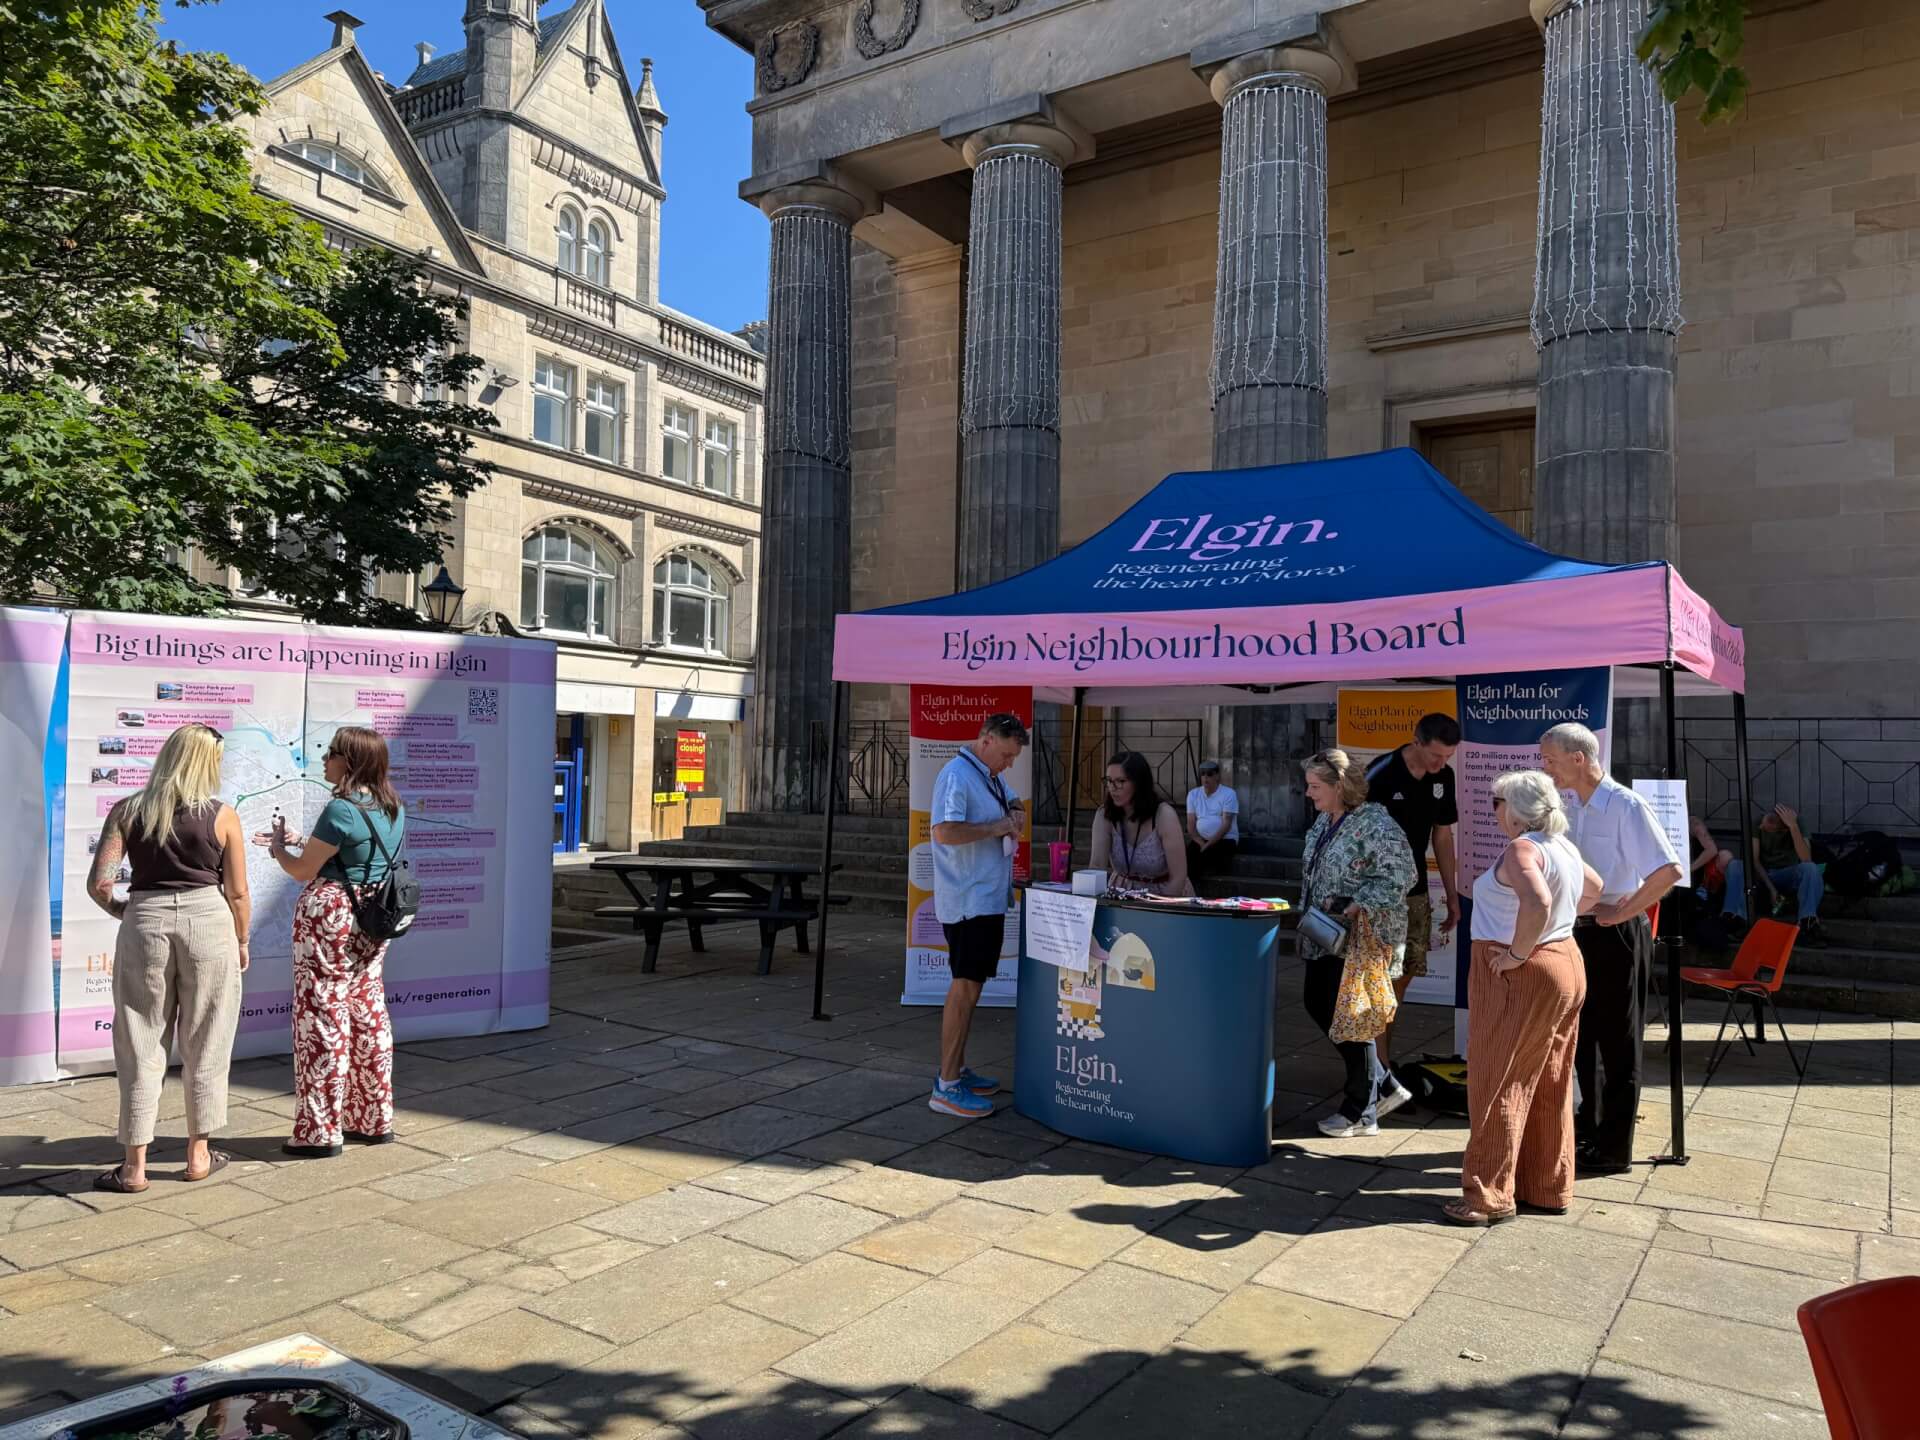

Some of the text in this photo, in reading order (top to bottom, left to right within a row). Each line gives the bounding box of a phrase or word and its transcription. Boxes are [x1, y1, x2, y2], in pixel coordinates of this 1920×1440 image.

[1128, 514, 1339, 561] Elgin.
[1106, 555, 1289, 577] Regenerating
[1092, 565, 1358, 590] the heart of Moray
[942, 606, 1467, 671] Elgin Neighbourhood Board
[95, 633, 487, 677] Big things are happening in Elgin
[920, 693, 999, 710] Elgin Plan for
[1466, 682, 1563, 703] Elgin Plan for
[1348, 704, 1424, 719] Elgin Plan for
[1466, 703, 1590, 724] Neighbourhoods
[679, 744, 706, 755] closing!
[1465, 751, 1542, 761] £20 million over 10
[1464, 761, 1483, 770] from
[1484, 762, 1496, 771] the
[1499, 763, 1511, 772] UK
[1472, 809, 1486, 817] Give
[1472, 841, 1503, 849] connected
[1055, 1045, 1123, 1086] Elgin.
[1055, 1080, 1112, 1105] Regenerating
[1055, 1093, 1136, 1123] the heart of Moray
